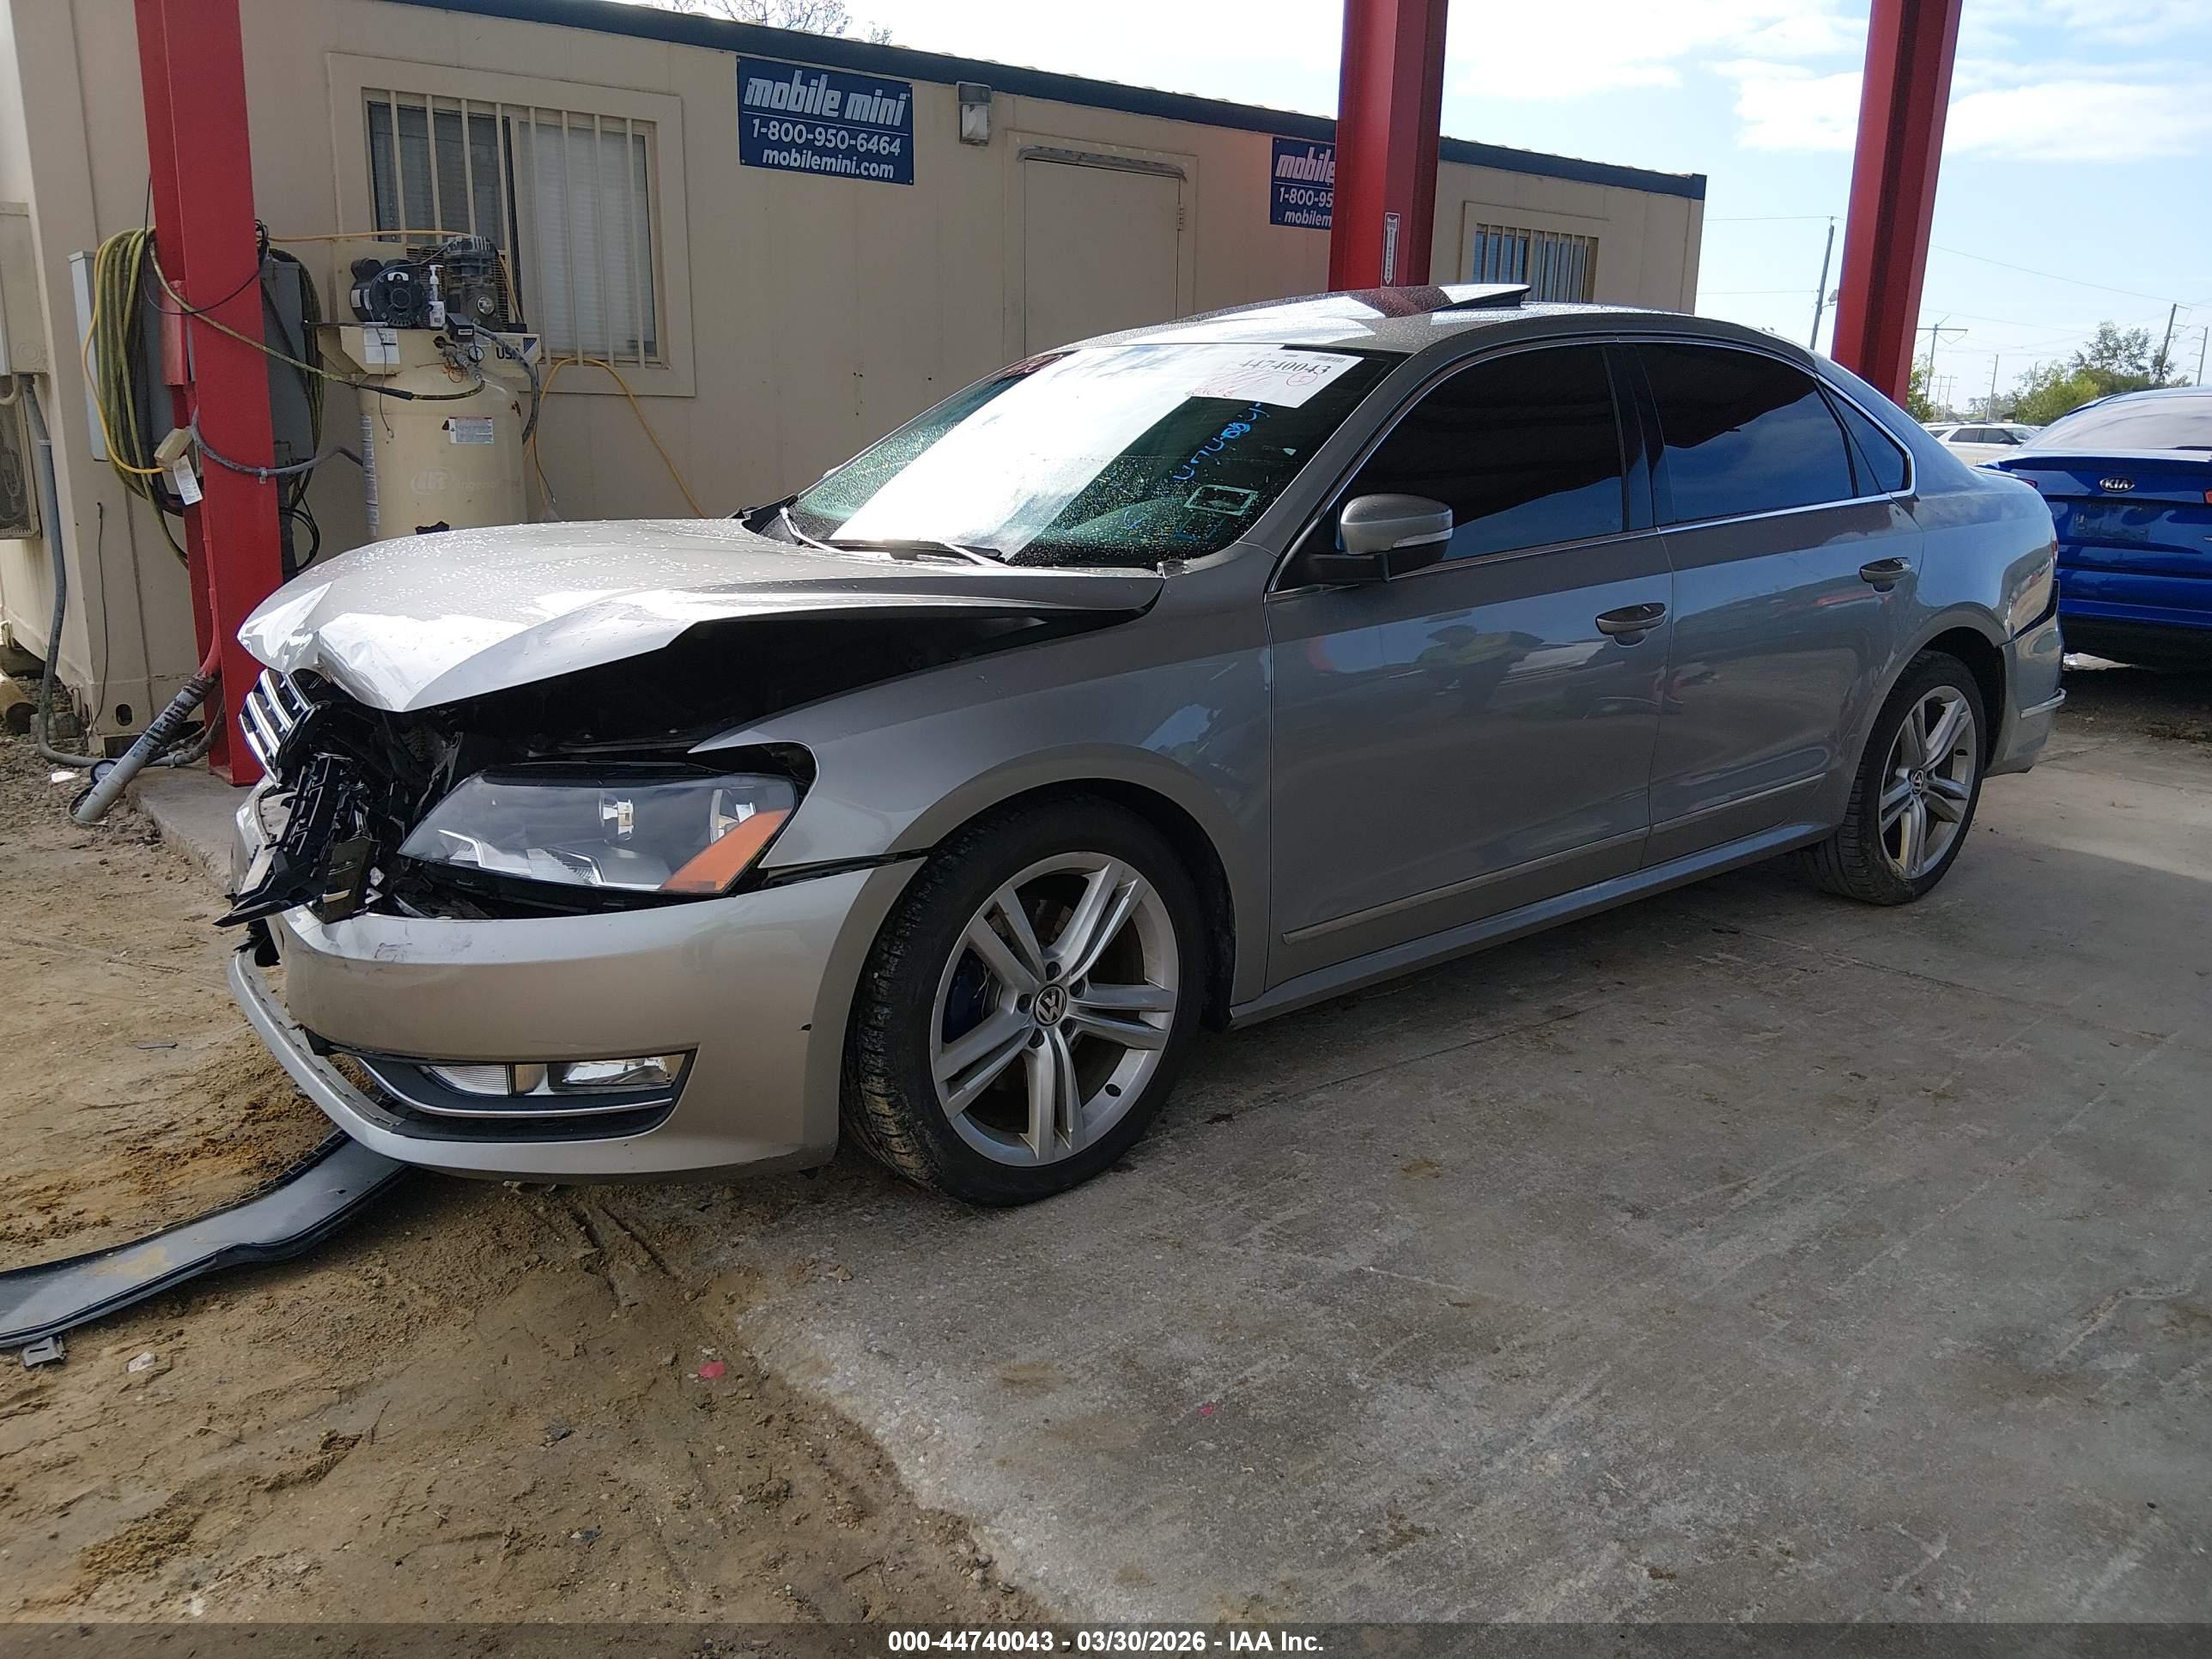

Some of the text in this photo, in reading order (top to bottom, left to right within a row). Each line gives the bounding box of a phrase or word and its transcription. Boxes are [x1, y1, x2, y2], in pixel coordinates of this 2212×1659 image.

[744, 70, 907, 126] mobile mini
[752, 118, 901, 156] 1-800-950-6464
[762, 149, 895, 179] mobilemini.com
[1275, 147, 1335, 184] mobile
[2104, 478, 2130, 489] KIA
